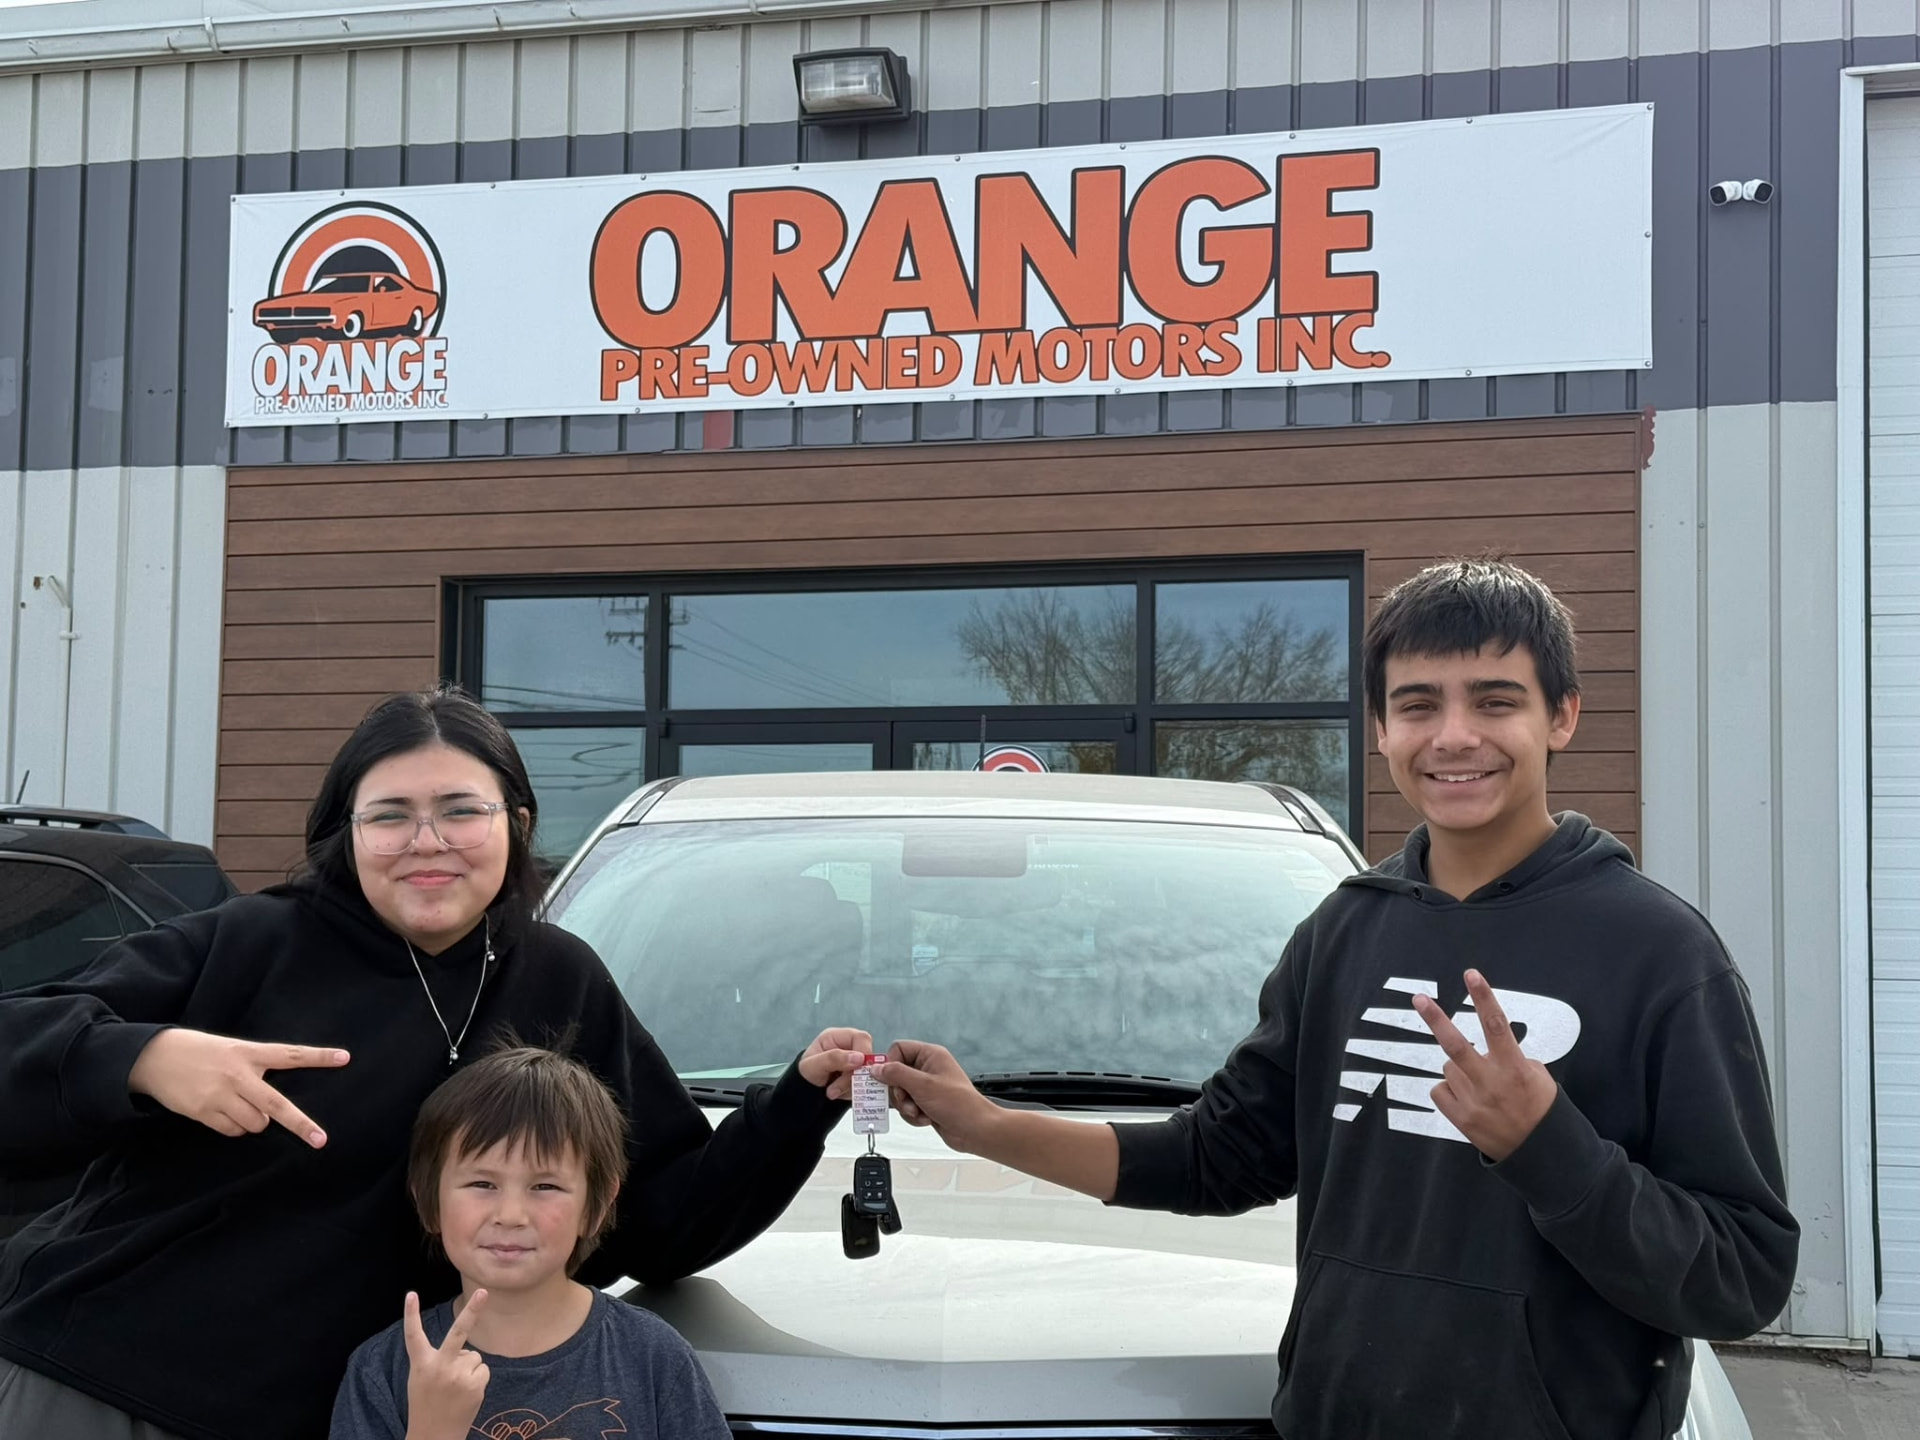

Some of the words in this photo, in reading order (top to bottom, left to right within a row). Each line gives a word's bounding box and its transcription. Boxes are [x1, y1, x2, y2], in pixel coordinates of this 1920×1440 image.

[589, 148, 1380, 349] ORANGE
[252, 337, 448, 398] ORANGE
[600, 335, 963, 401] PRE-OWNED
[973, 318, 1243, 386] MOTORS
[1256, 310, 1392, 374] INC.
[254, 393, 347, 415] PRE-OWNED
[349, 390, 414, 412] MOTORS
